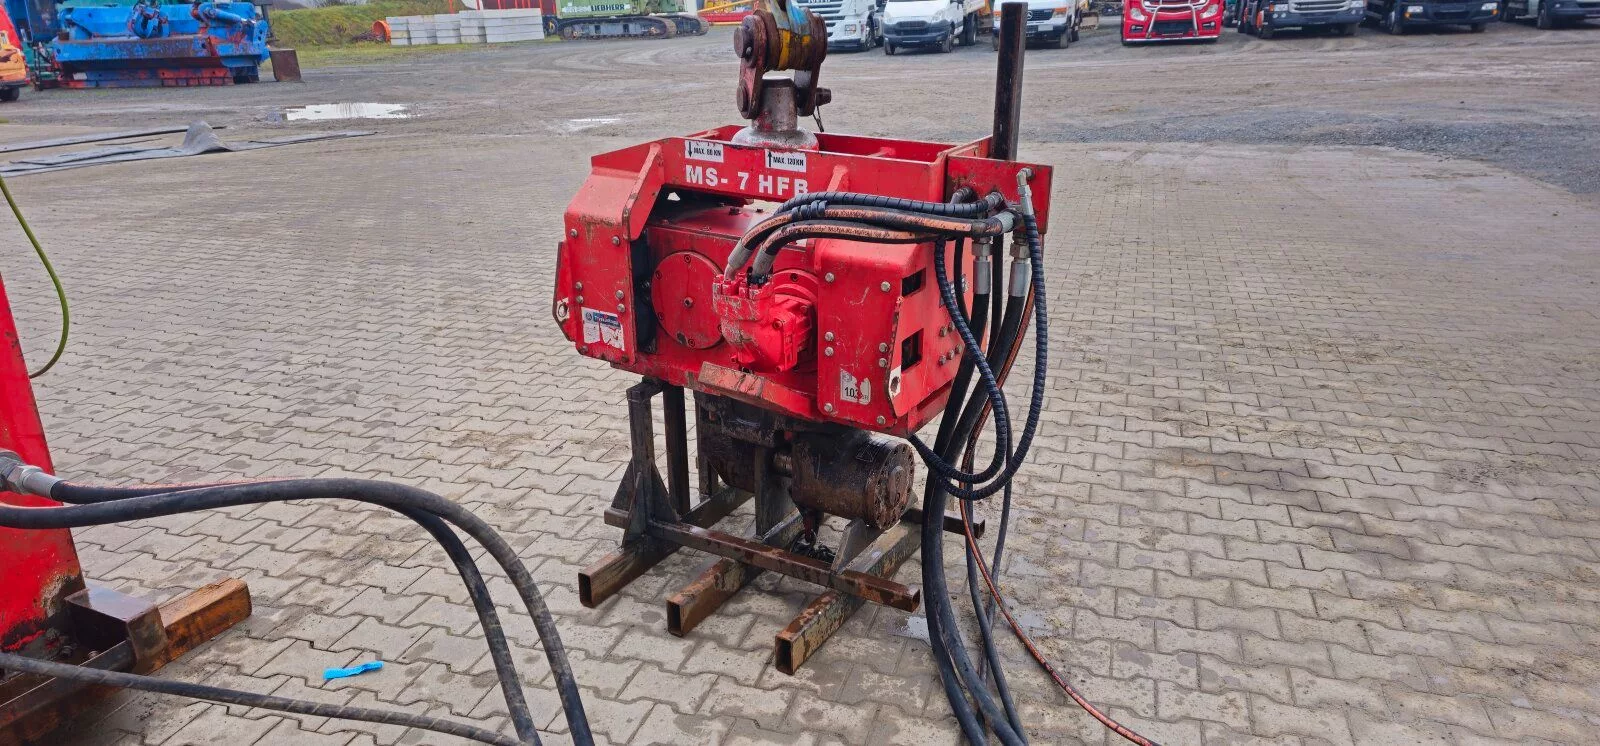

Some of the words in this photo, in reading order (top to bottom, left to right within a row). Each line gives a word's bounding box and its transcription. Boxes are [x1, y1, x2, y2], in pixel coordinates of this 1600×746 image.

[591, 4, 625, 12] LIEBHERR
[773, 156, 787, 165] MAX.
[737, 171, 750, 191] 7
[758, 174, 809, 196] HFB
